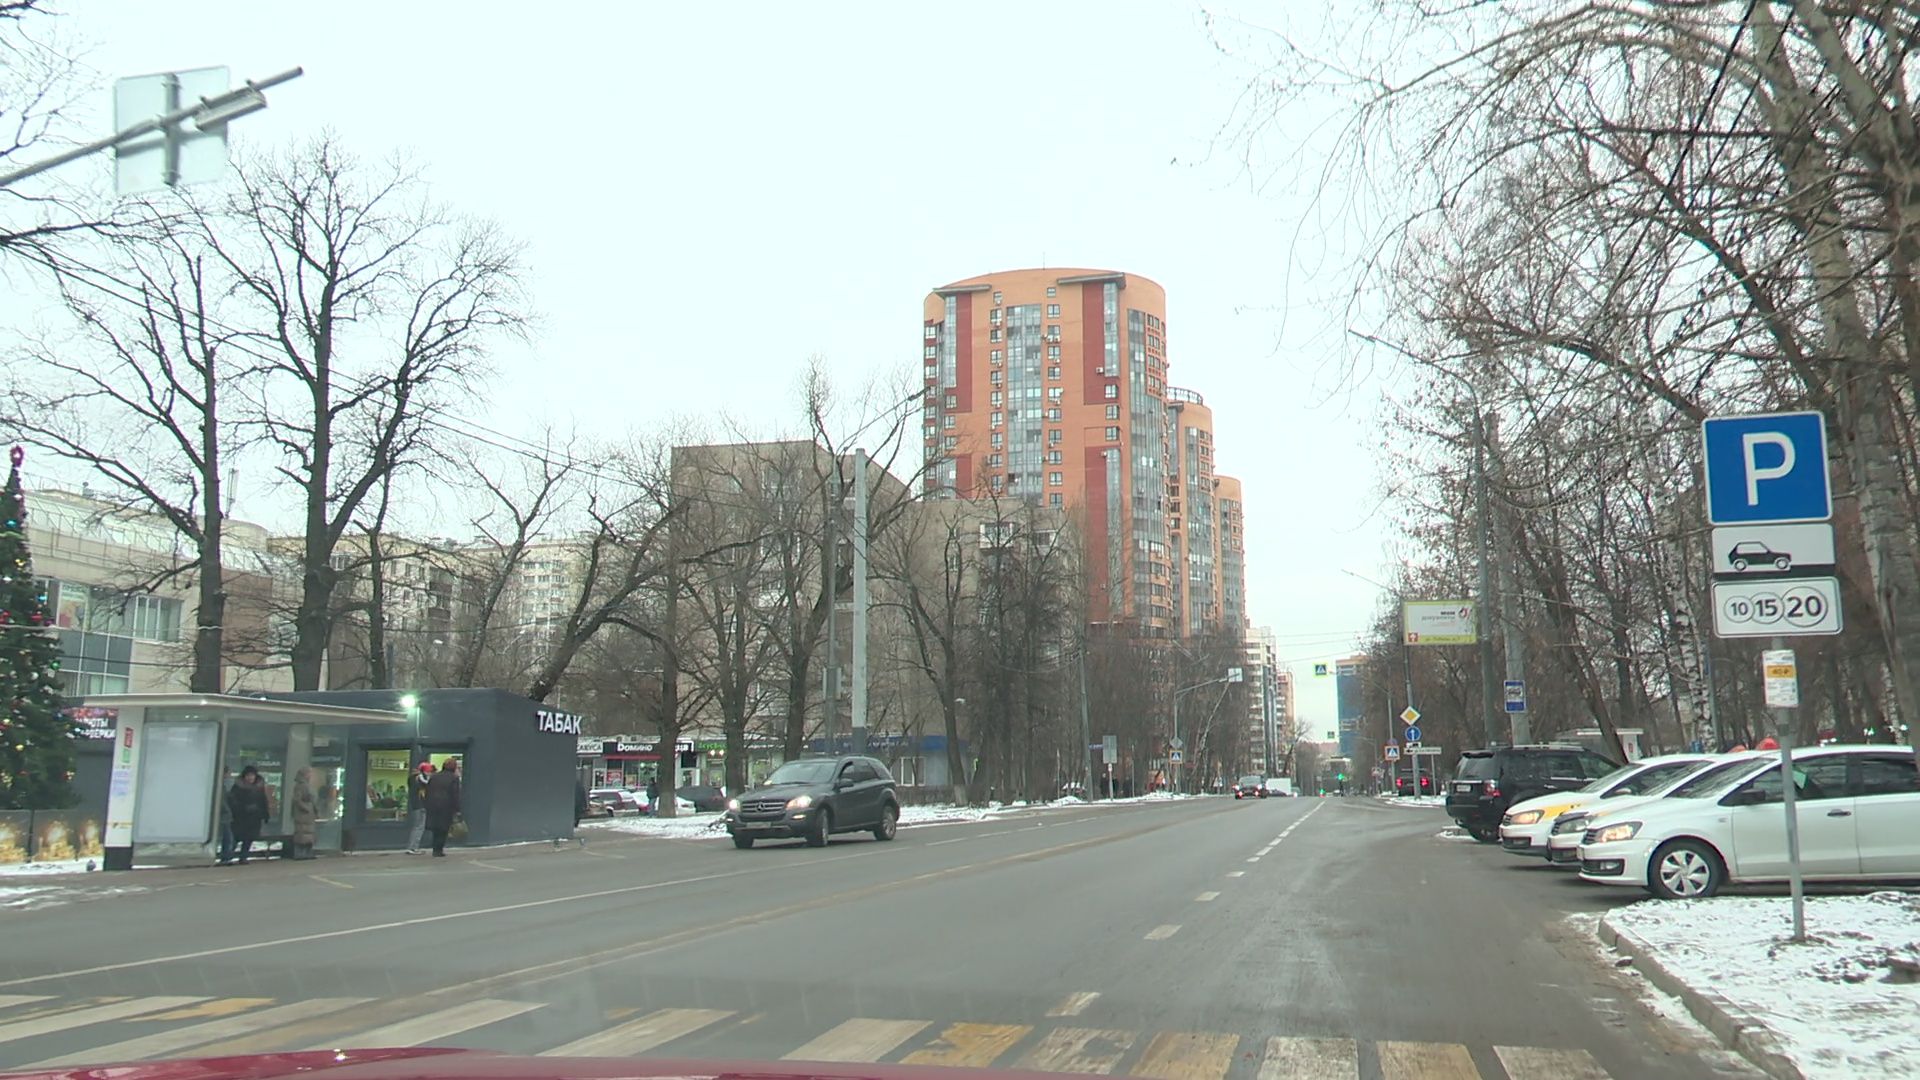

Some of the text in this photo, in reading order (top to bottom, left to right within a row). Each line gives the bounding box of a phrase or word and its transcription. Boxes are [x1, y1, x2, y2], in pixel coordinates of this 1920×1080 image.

[1742, 431, 1796, 506] P
[1730, 595, 1823, 618] 10 15 20
[537, 710, 582, 735] ТАБАК
